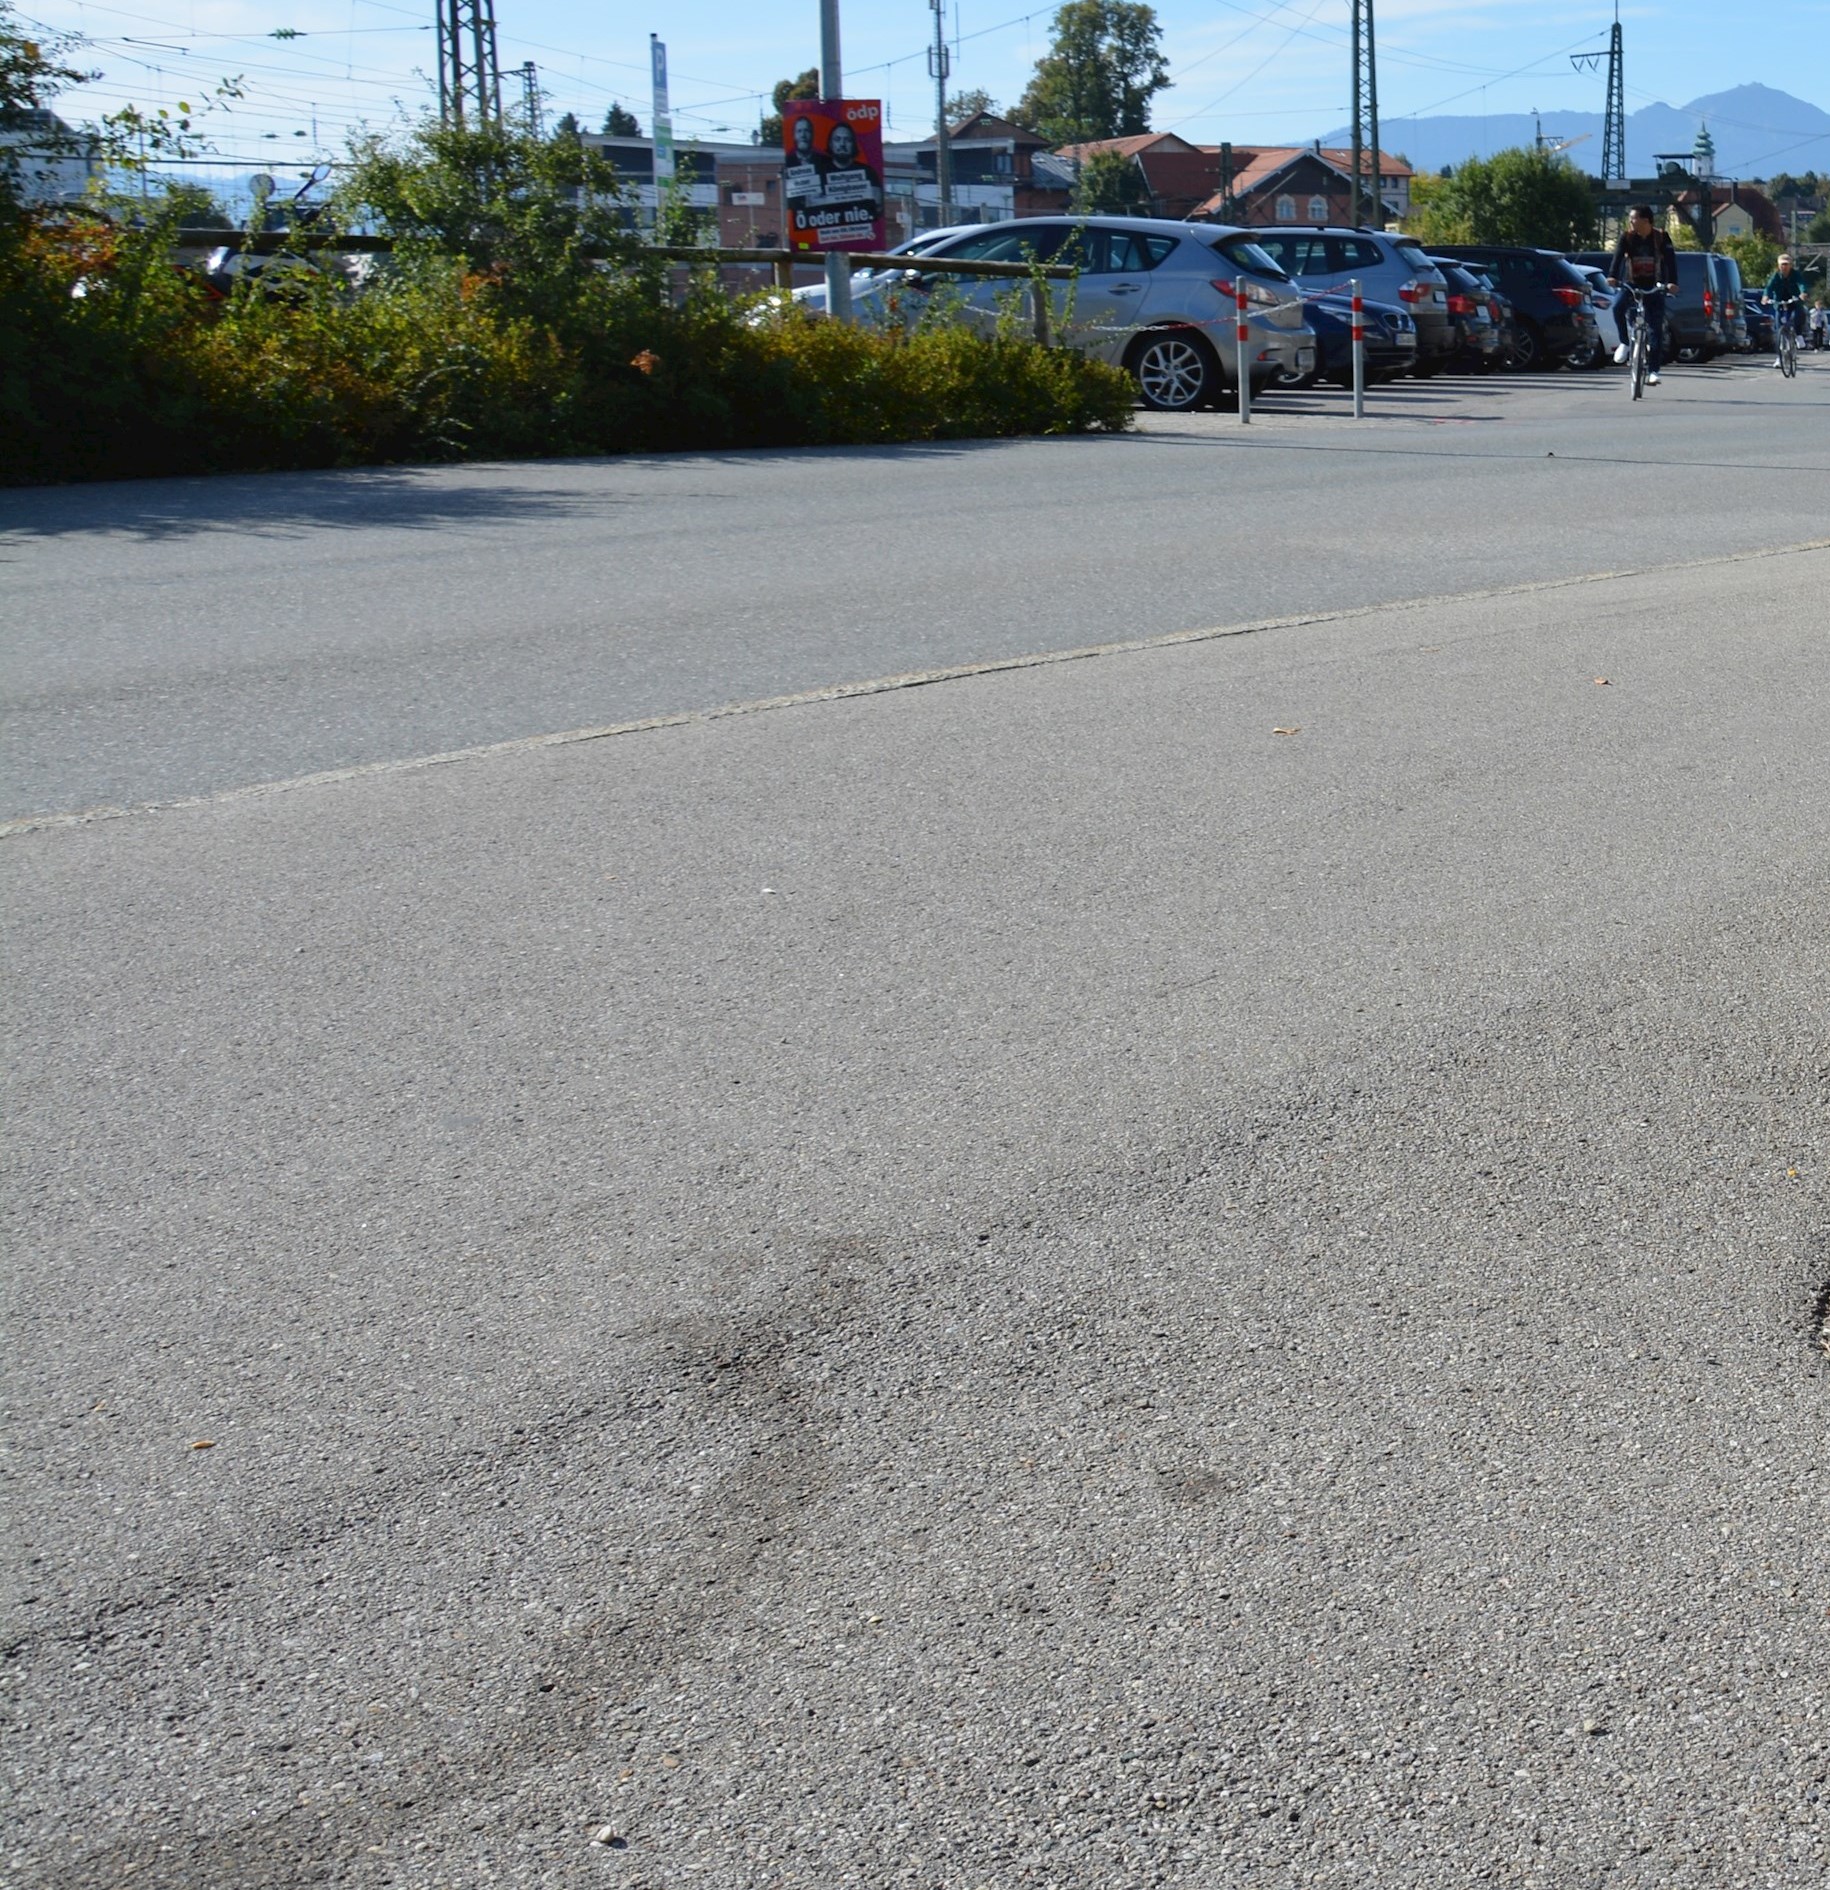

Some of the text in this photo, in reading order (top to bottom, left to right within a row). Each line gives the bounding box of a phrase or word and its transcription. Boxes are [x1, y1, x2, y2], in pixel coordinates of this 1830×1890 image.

[847, 104, 879, 121] ödp
[795, 205, 874, 229] Ö oder nie.
